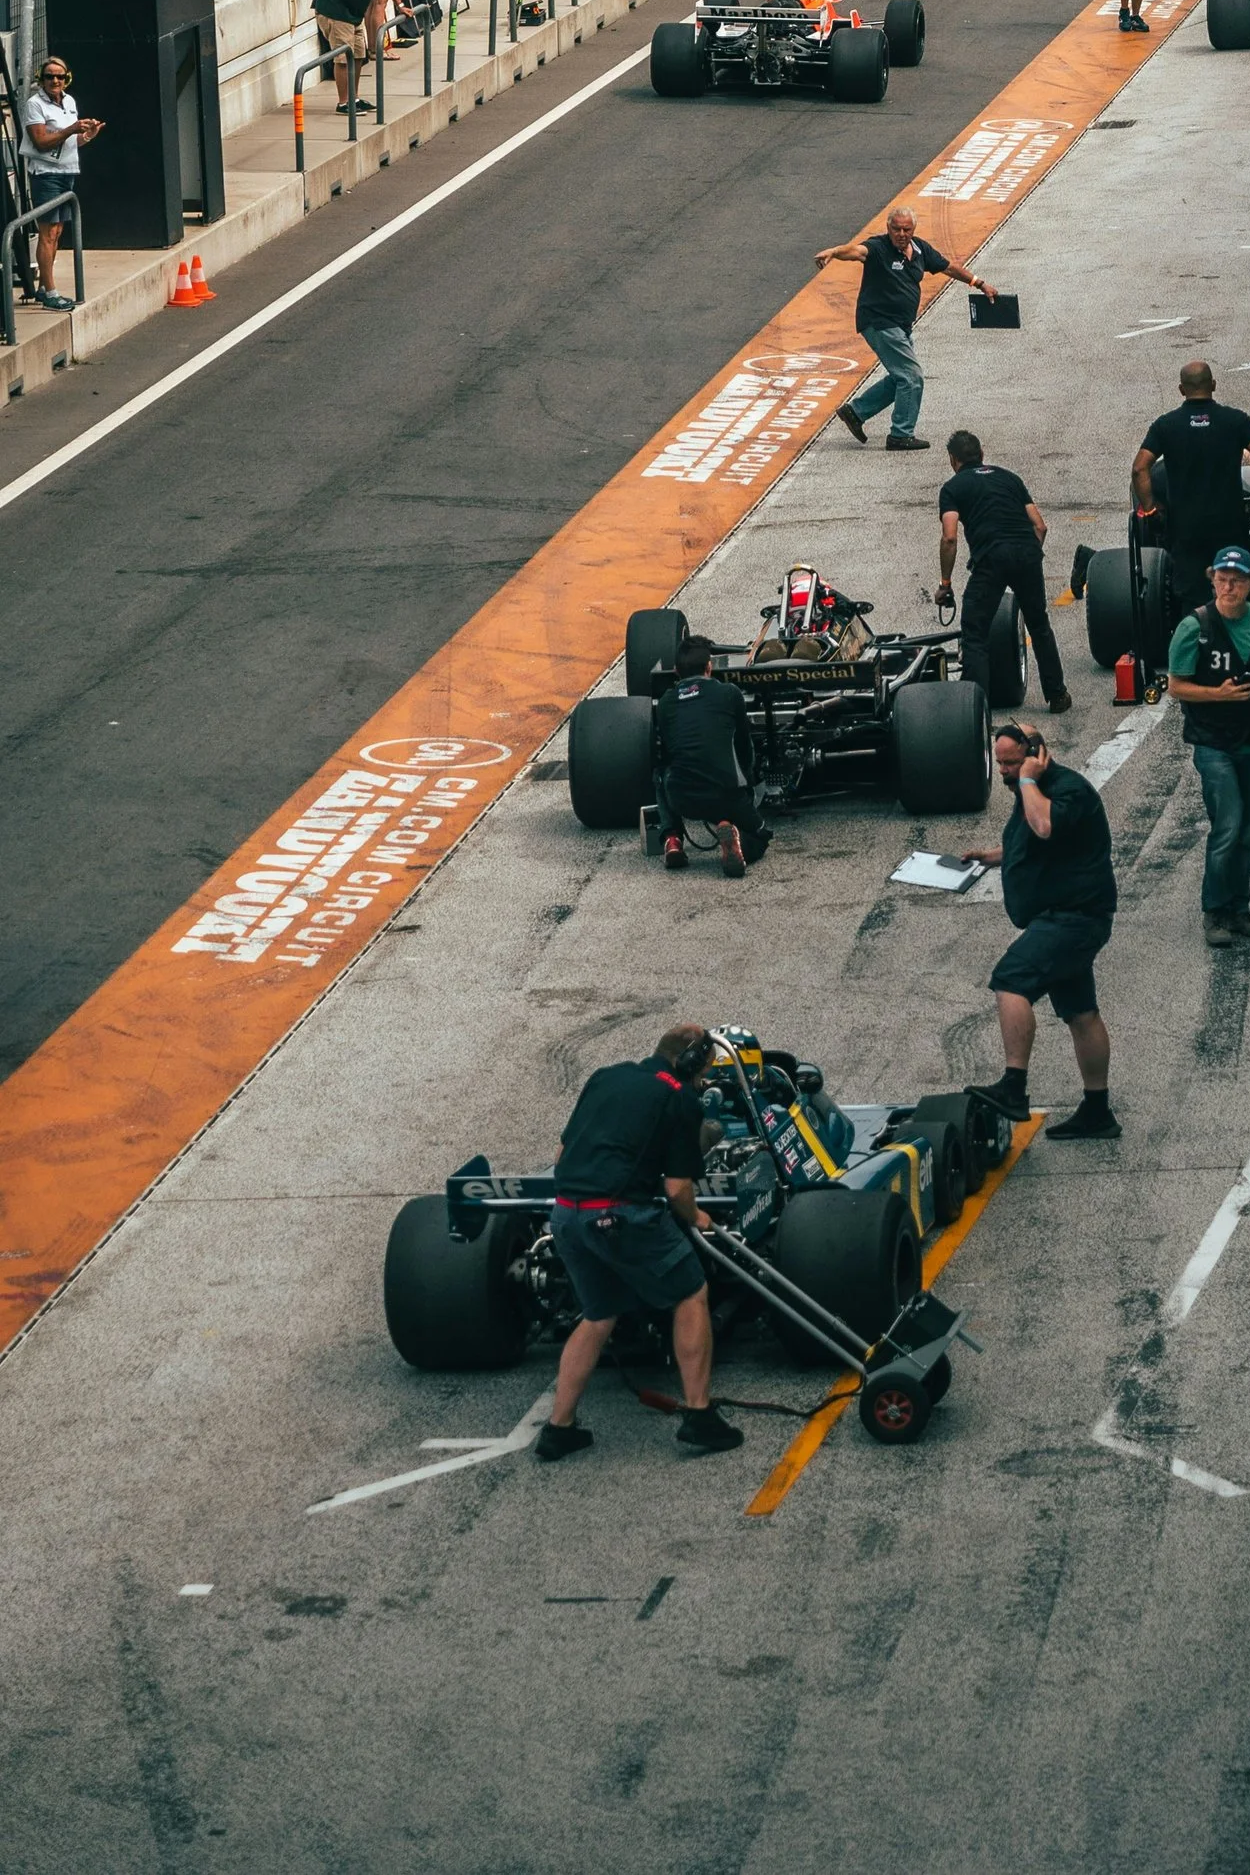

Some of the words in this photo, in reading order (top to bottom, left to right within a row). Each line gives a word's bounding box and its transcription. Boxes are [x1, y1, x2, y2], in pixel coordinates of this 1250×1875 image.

[710, 7, 809, 19] Marlboro
[770, 377, 839, 430] CM.COM
[719, 430, 792, 486] CIRCUIT
[786, 664, 856, 682] Special
[1210, 650, 1232, 671] 31
[365, 776, 478, 865] CM.COM
[275, 870, 393, 968] CIRCUIT
[461, 1176, 524, 1199] elf
[919, 1146, 934, 1192] elf
